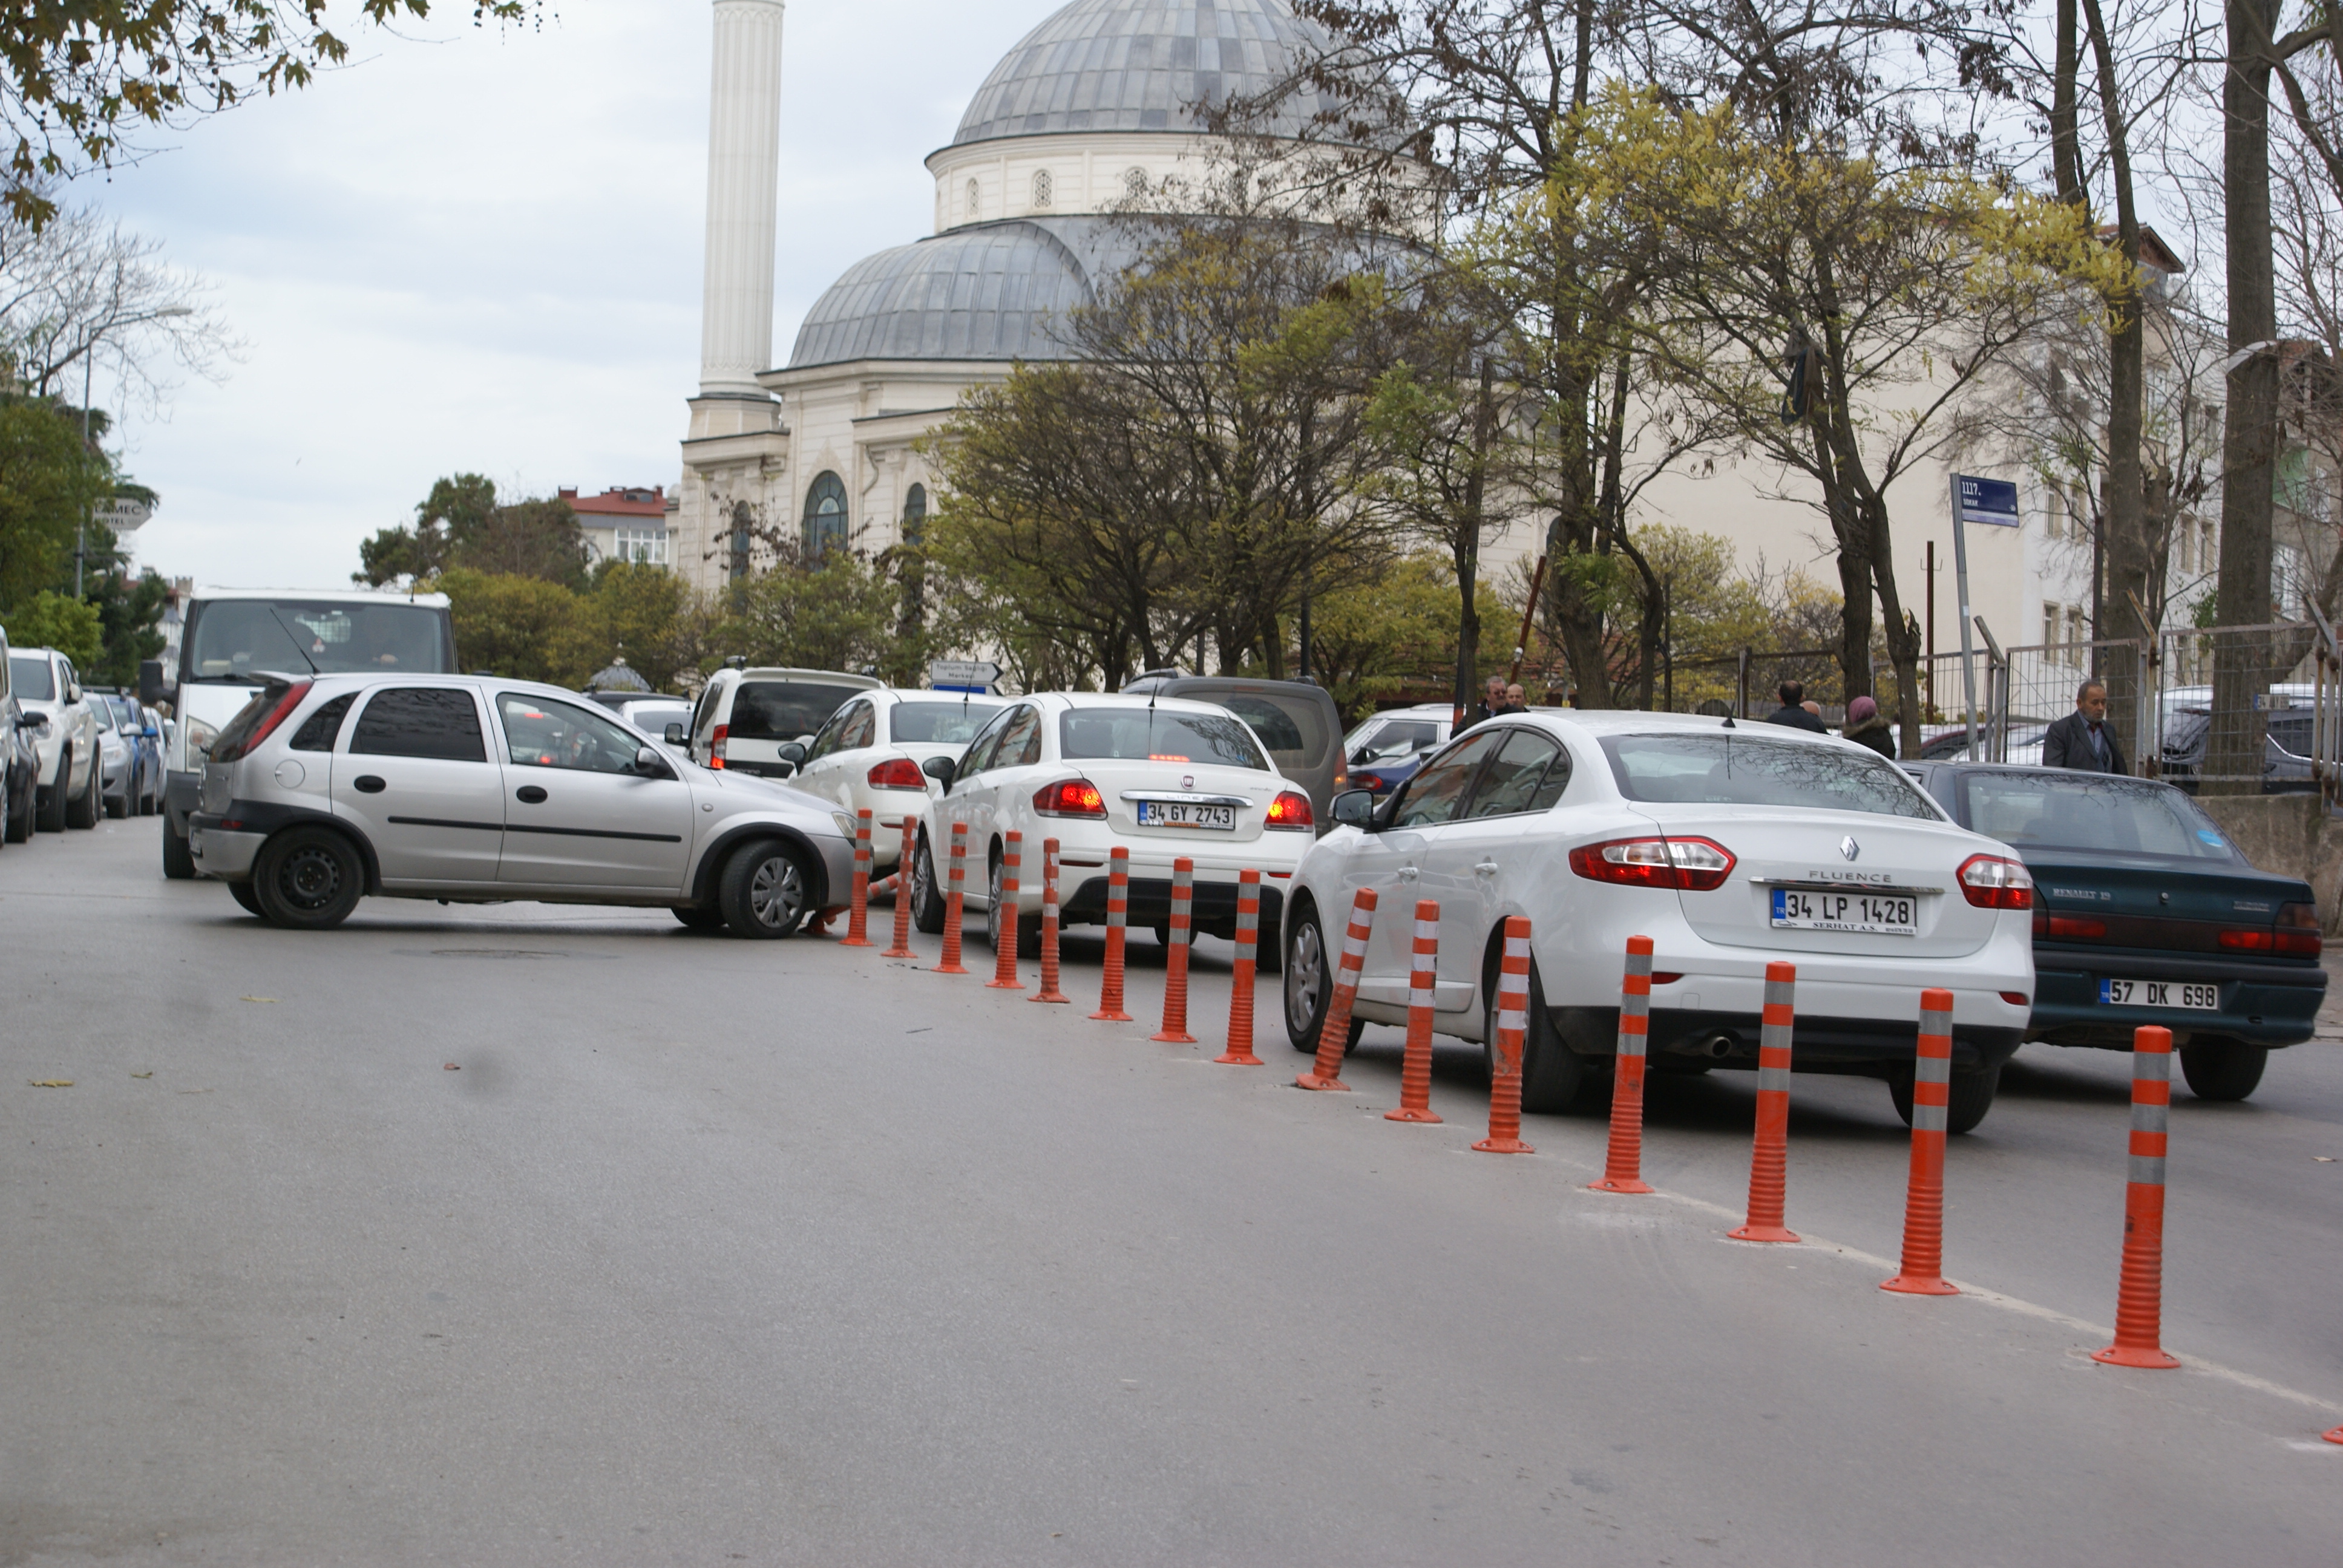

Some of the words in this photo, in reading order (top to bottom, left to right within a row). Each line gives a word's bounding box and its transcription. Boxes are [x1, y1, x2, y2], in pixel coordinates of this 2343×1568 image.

[1961, 481, 1981, 496] 1117.
[1963, 498, 1978, 507] SOKAK
[1149, 805, 1165, 820] 34
[1171, 805, 1188, 822] GY
[1196, 807, 1230, 824] 2743
[1809, 870, 1892, 883] FLUENCE
[2053, 888, 2097, 899] RENAULT
[1787, 894, 1812, 919] 34
[1823, 896, 1847, 920] LP
[1860, 898, 1909, 924] 1428
[1813, 921, 1857, 930] SERHAT
[2111, 981, 2134, 1002] 57
[2148, 983, 2169, 1005] DK
[2183, 985, 2215, 1007] 698
